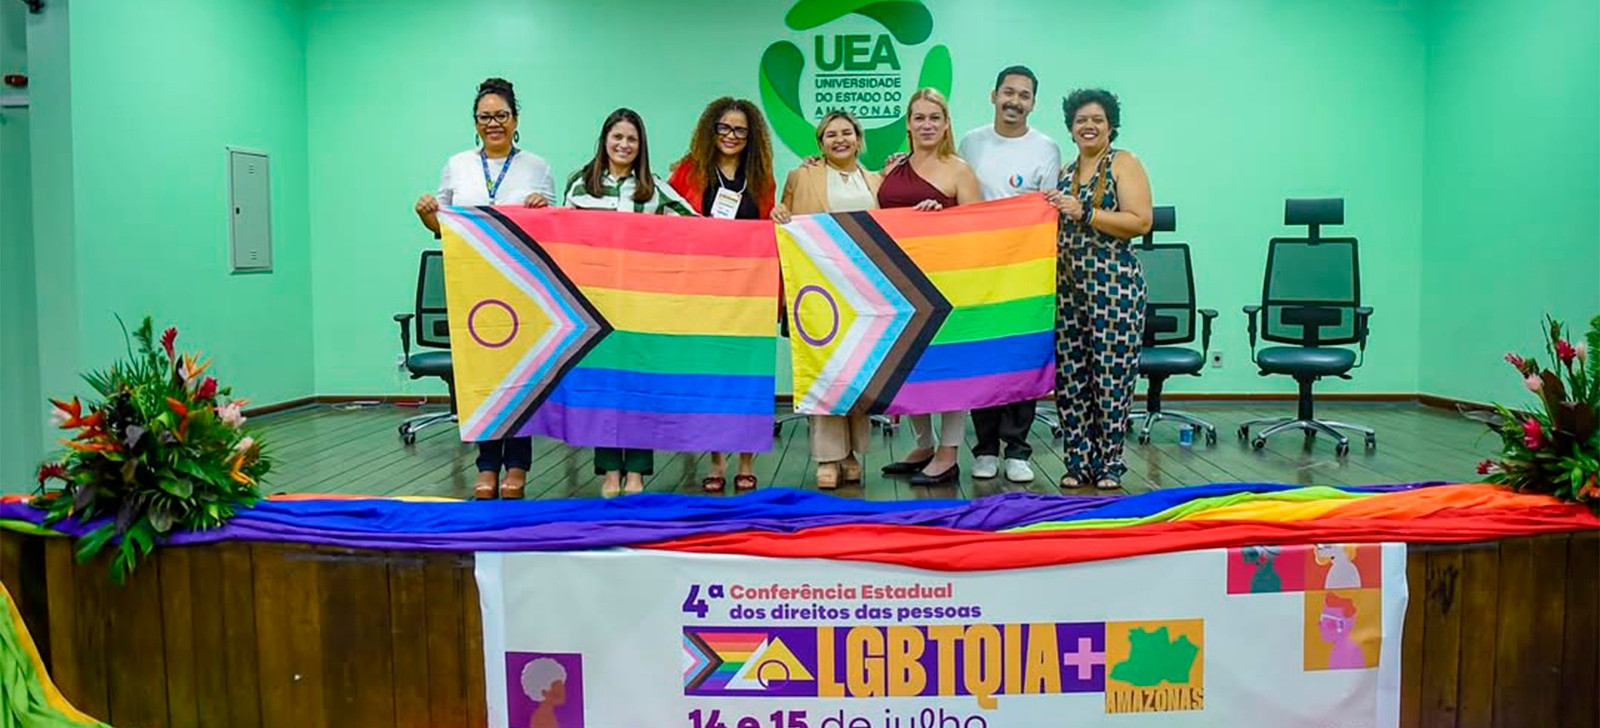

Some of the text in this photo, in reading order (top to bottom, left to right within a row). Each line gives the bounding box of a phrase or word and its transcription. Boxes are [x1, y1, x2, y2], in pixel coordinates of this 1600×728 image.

[815, 34, 901, 71] UEA
[815, 78, 901, 88] UNIVERSIDADE
[815, 91, 901, 102] DO ESTADO DO
[729, 584, 857, 600] Conferência
[861, 583, 953, 599] Estadual
[729, 603, 982, 622] dos direitos das pessoas
[1105, 687, 1206, 713] AMAZONAS
[688, 709, 728, 728] 14
[770, 710, 810, 728] 15
